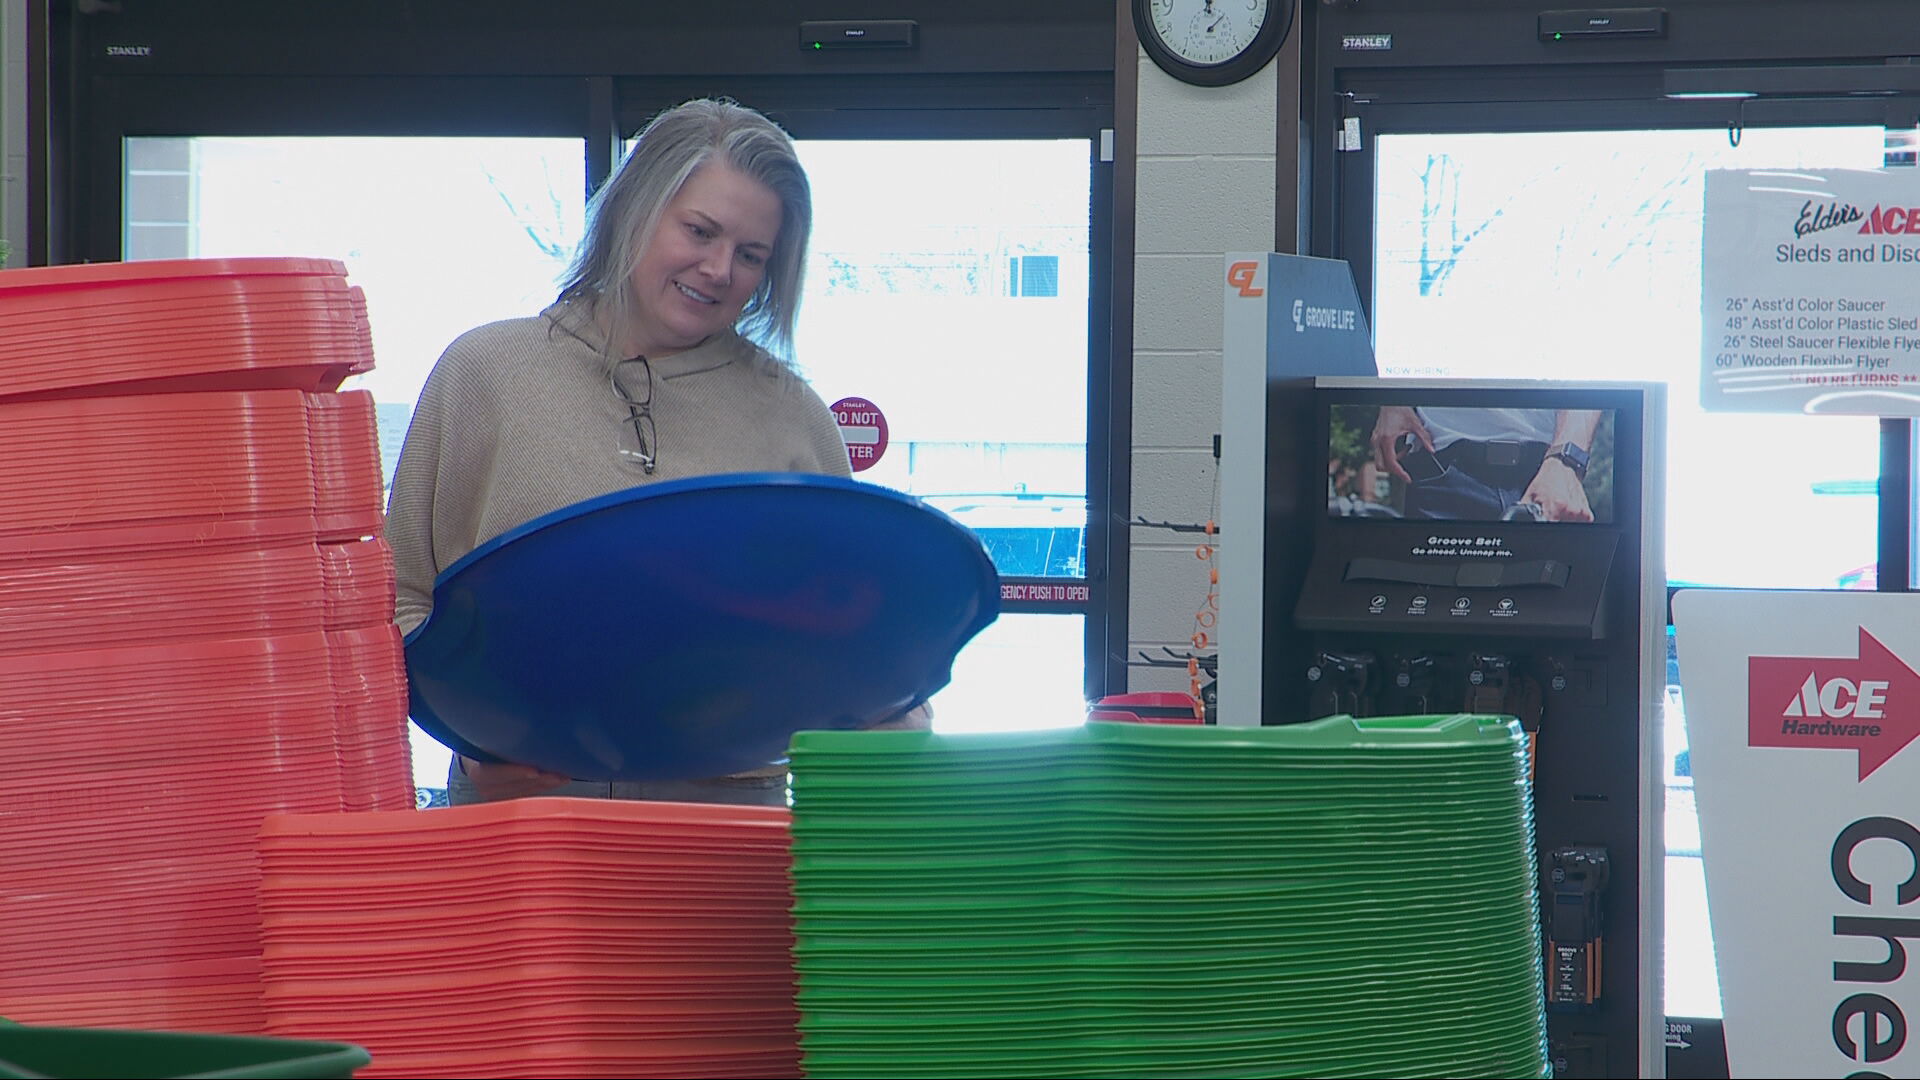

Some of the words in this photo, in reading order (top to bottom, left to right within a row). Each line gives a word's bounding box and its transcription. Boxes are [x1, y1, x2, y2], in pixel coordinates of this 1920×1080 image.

[1343, 38, 1389, 47] STANLEY
[106, 46, 151, 56] STANLEY
[1857, 202, 1920, 235] ACE
[1776, 243, 1831, 262] Sleds
[1838, 243, 1875, 262] and
[1726, 298, 1748, 311] 26"
[1752, 298, 1794, 311] Asst'd
[1797, 298, 1834, 311] Color
[1838, 298, 1886, 312] Saucer
[1306, 306, 1337, 329] GROOVE
[1337, 309, 1355, 330] LIFE
[1725, 317, 1748, 330] 48"
[1752, 317, 1794, 330] Asst'd
[1797, 317, 1834, 330] Color
[1837, 317, 1884, 330] Plastic
[1888, 317, 1918, 330] Sled
[1723, 335, 1746, 348] 26"
[1750, 335, 1784, 348] Steel
[1787, 335, 1834, 349] Saucer
[1837, 335, 1891, 349] Flexible
[1715, 353, 1738, 367] 60"
[1741, 353, 1797, 367] Wooden
[1801, 354, 1853, 367] Flexible
[1856, 355, 1890, 370] Flyer
[1385, 367, 1410, 376] NOW
[851, 411, 879, 424] NOT
[1427, 536, 1472, 545] Groove
[1475, 537, 1502, 546] Belt
[1460, 548, 1494, 557] Unsnap
[1029, 585, 1051, 599] PUSH
[1054, 586, 1065, 600] TO
[1067, 586, 1089, 600] OPEN
[1782, 670, 1889, 719] ACE
[1781, 719, 1882, 737] Hardware
[1830, 816, 1920, 1079] Che
[1670, 1024, 1692, 1033] DOOR
